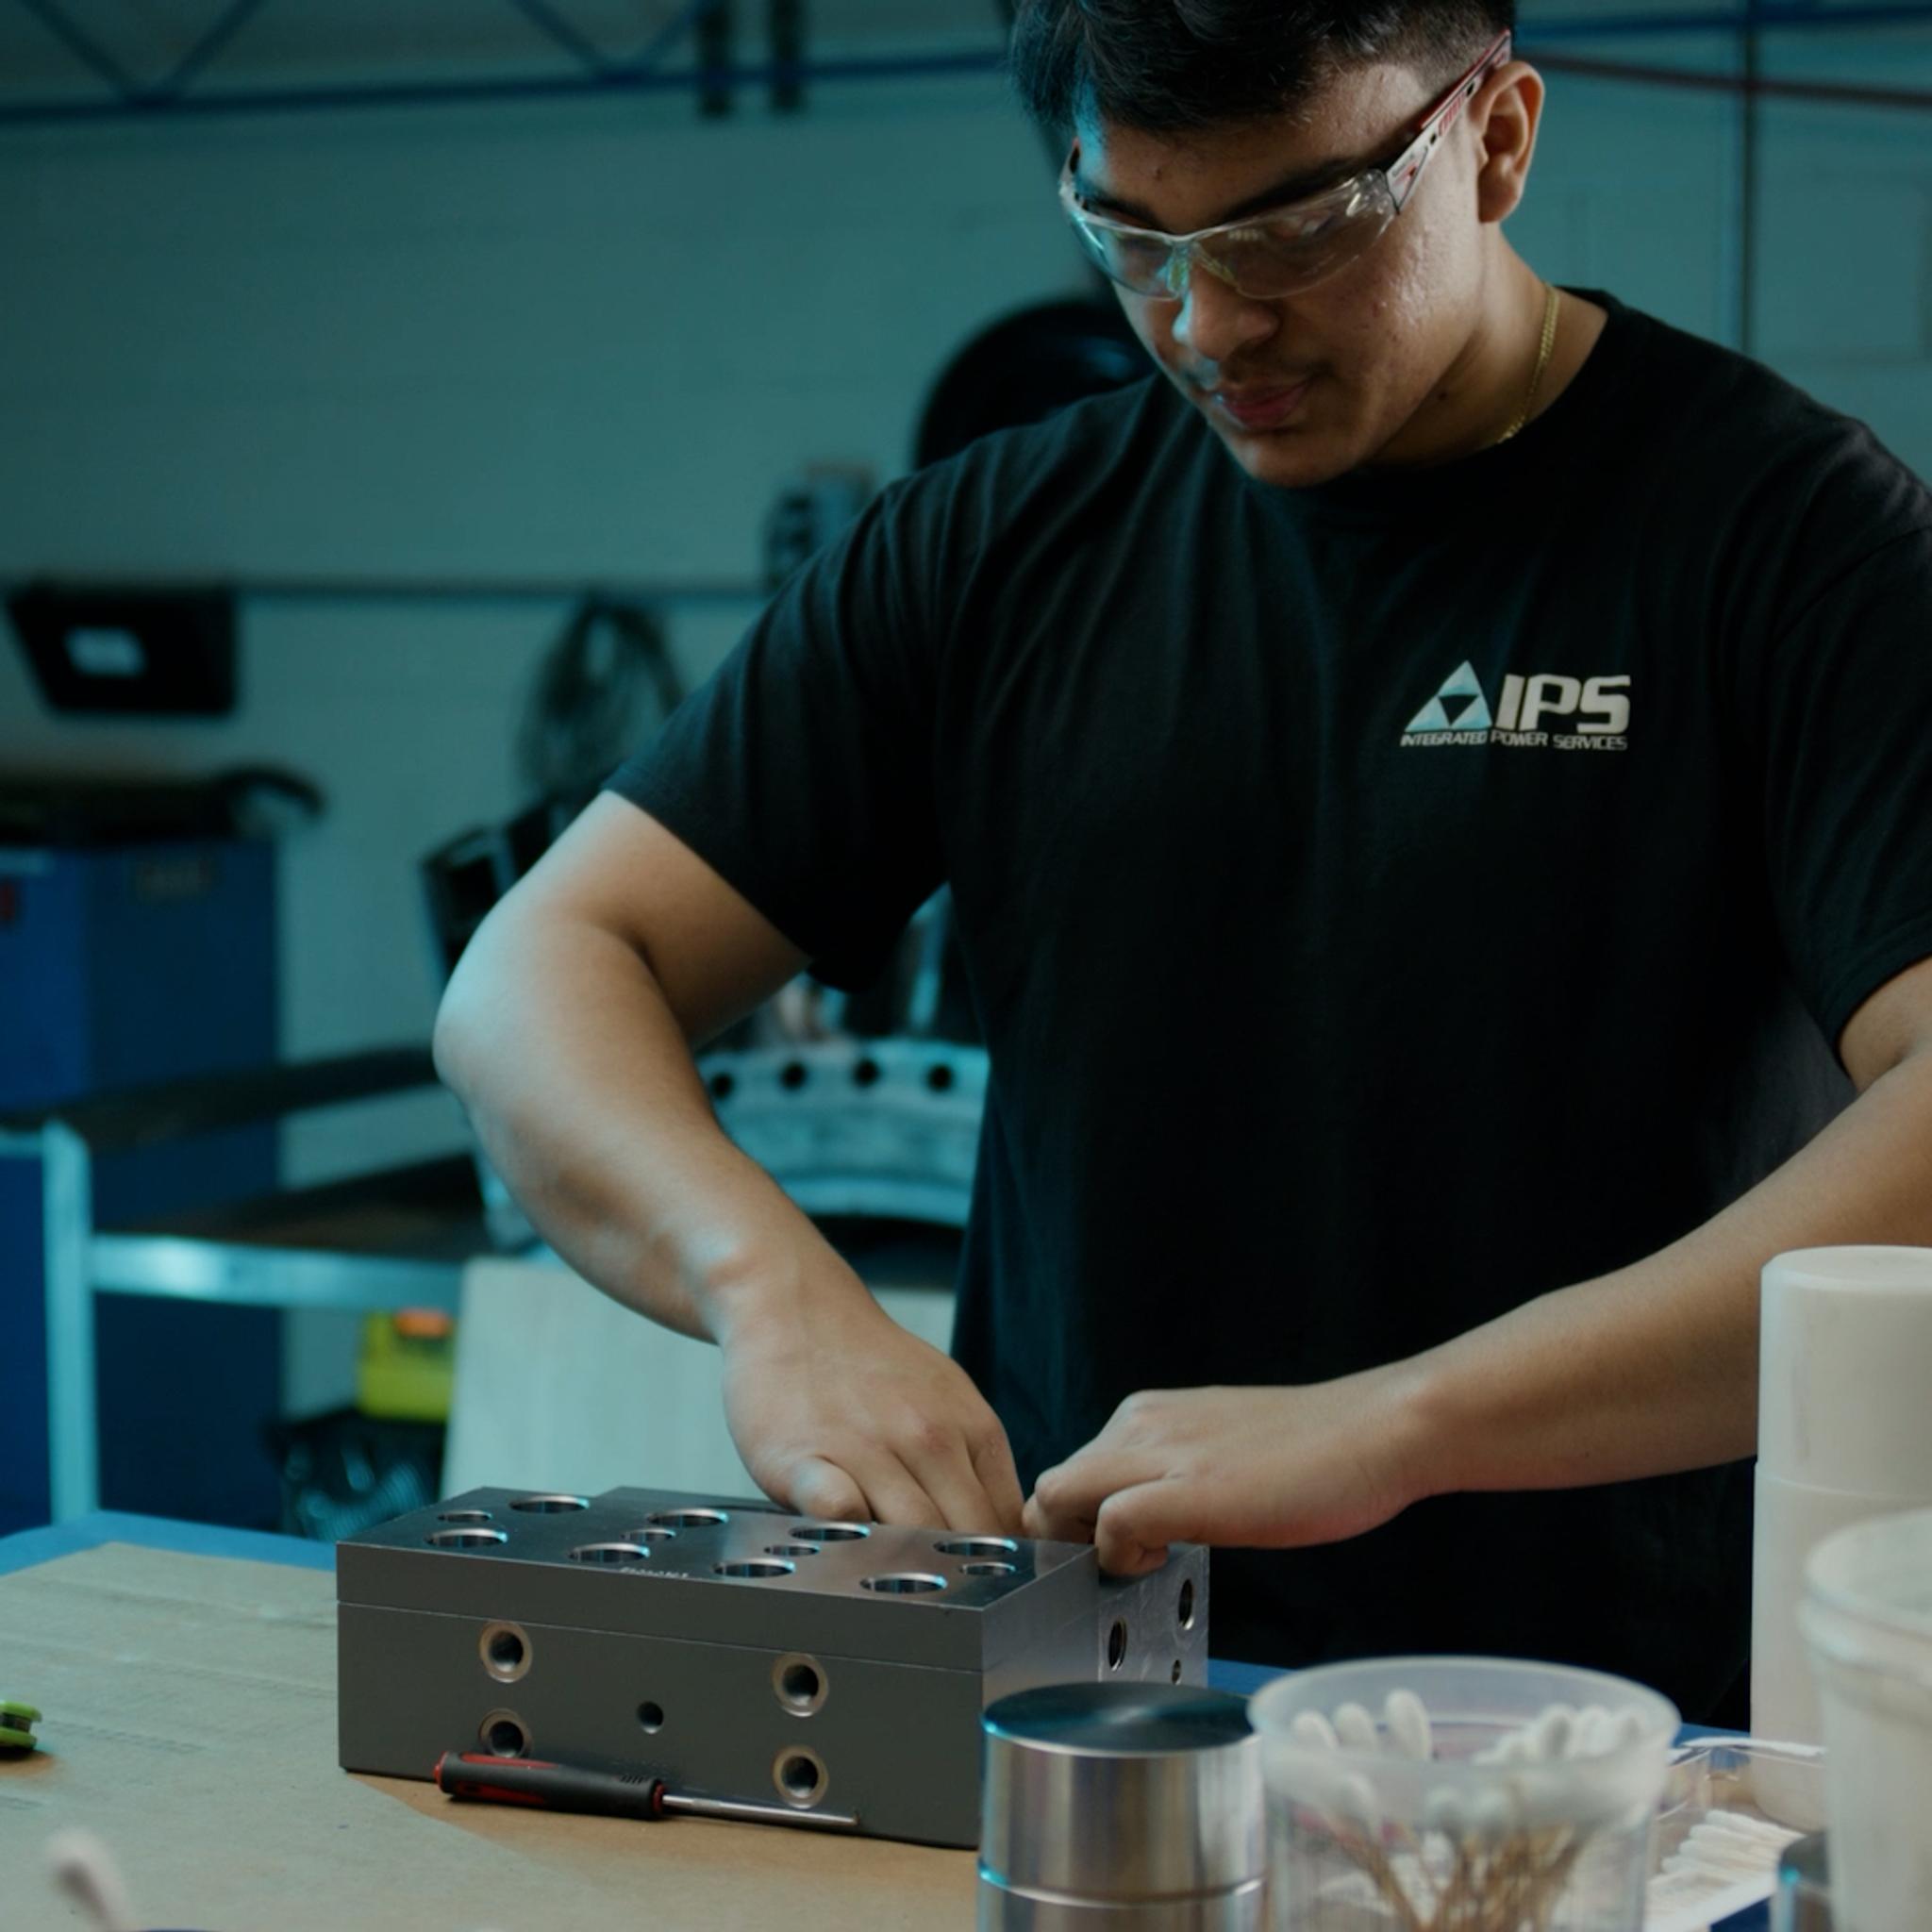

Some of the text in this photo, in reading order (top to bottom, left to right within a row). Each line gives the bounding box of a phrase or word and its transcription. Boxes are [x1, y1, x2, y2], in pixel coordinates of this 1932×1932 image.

[1495, 674, 1630, 733] IPS
[1400, 730, 1628, 751] INTEGRATED POWER SERVICES
